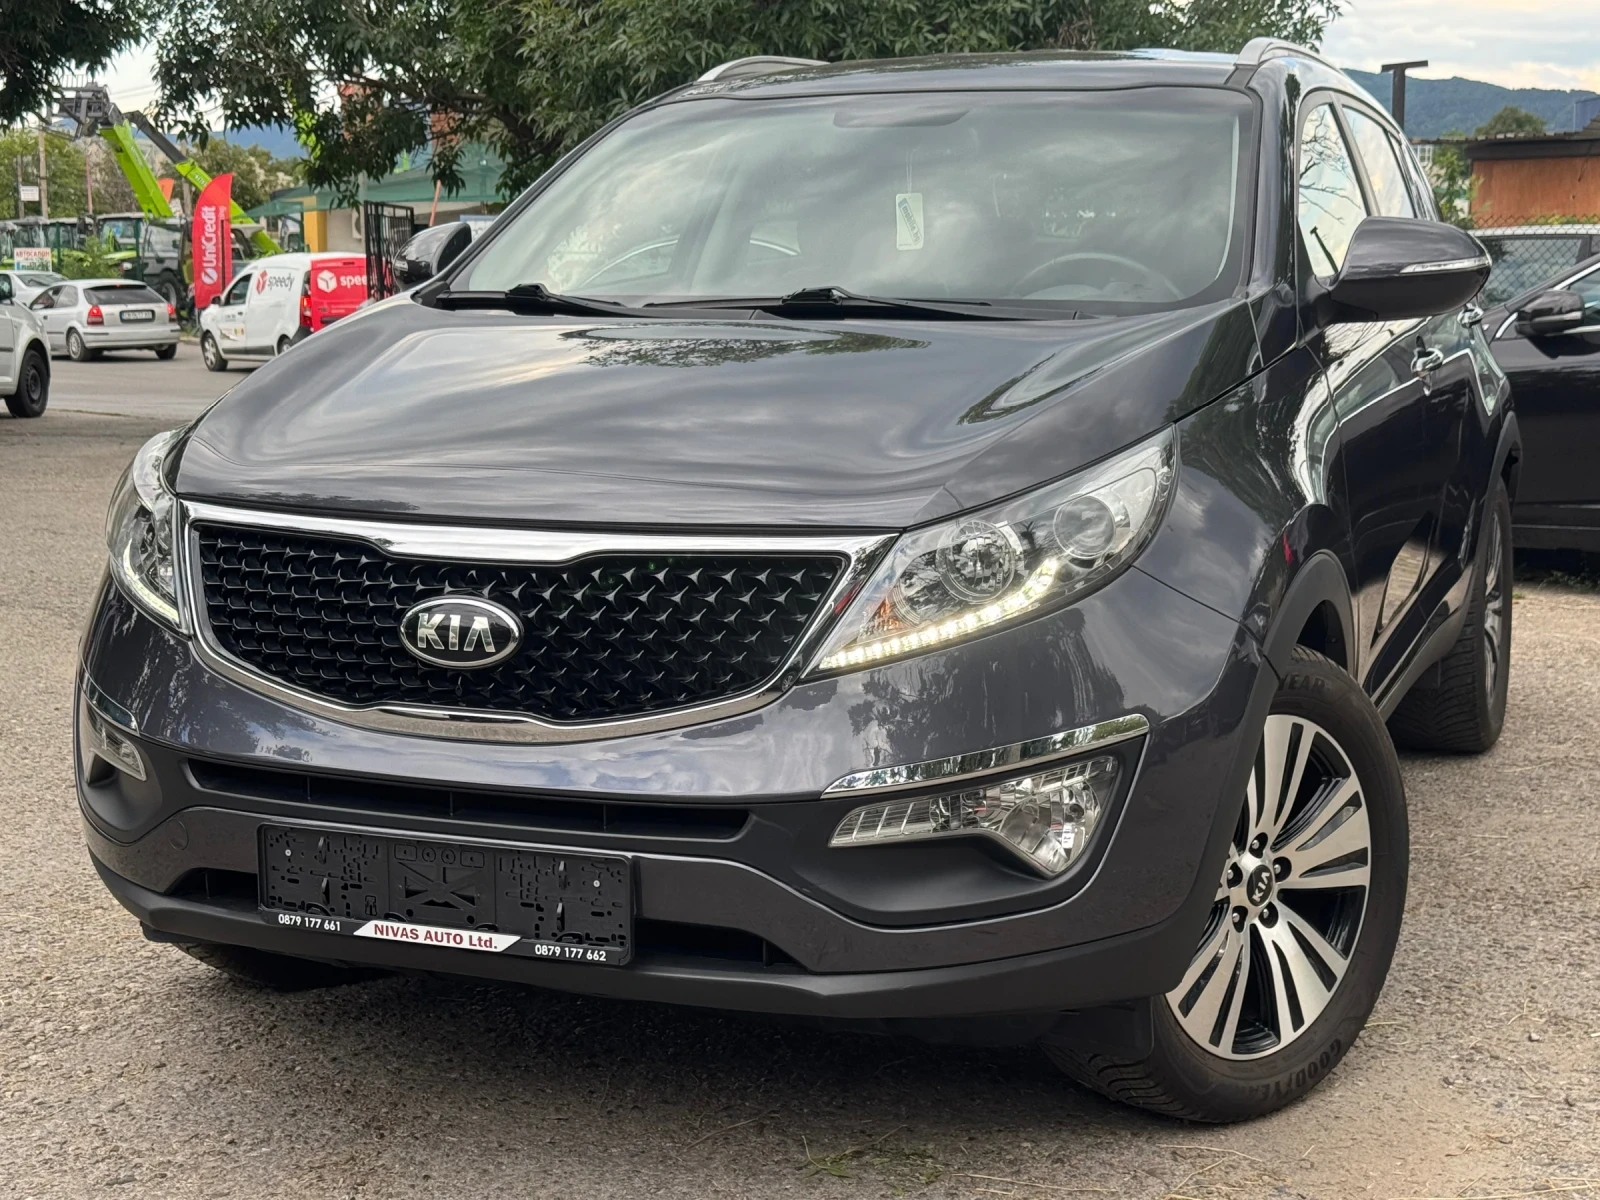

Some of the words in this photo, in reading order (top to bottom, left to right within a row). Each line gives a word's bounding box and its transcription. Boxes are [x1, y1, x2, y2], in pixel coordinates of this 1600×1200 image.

[201, 206, 217, 268] UniCredit
[268, 273, 295, 291] speedy
[340, 275, 367, 289] spee
[417, 612, 496, 653] KIA
[1252, 871, 1270, 902] KIA
[278, 913, 301, 926] 0879
[304, 917, 321, 929] 177
[324, 919, 340, 931] 661
[374, 923, 419, 940] NIVAS
[423, 930, 464, 945] AUTO
[468, 934, 498, 949] Ltd.
[535, 944, 561, 957] 0879
[564, 947, 584, 959] 177
[586, 949, 607, 961] 662
[1240, 1038, 1342, 1101] GOODYEA
